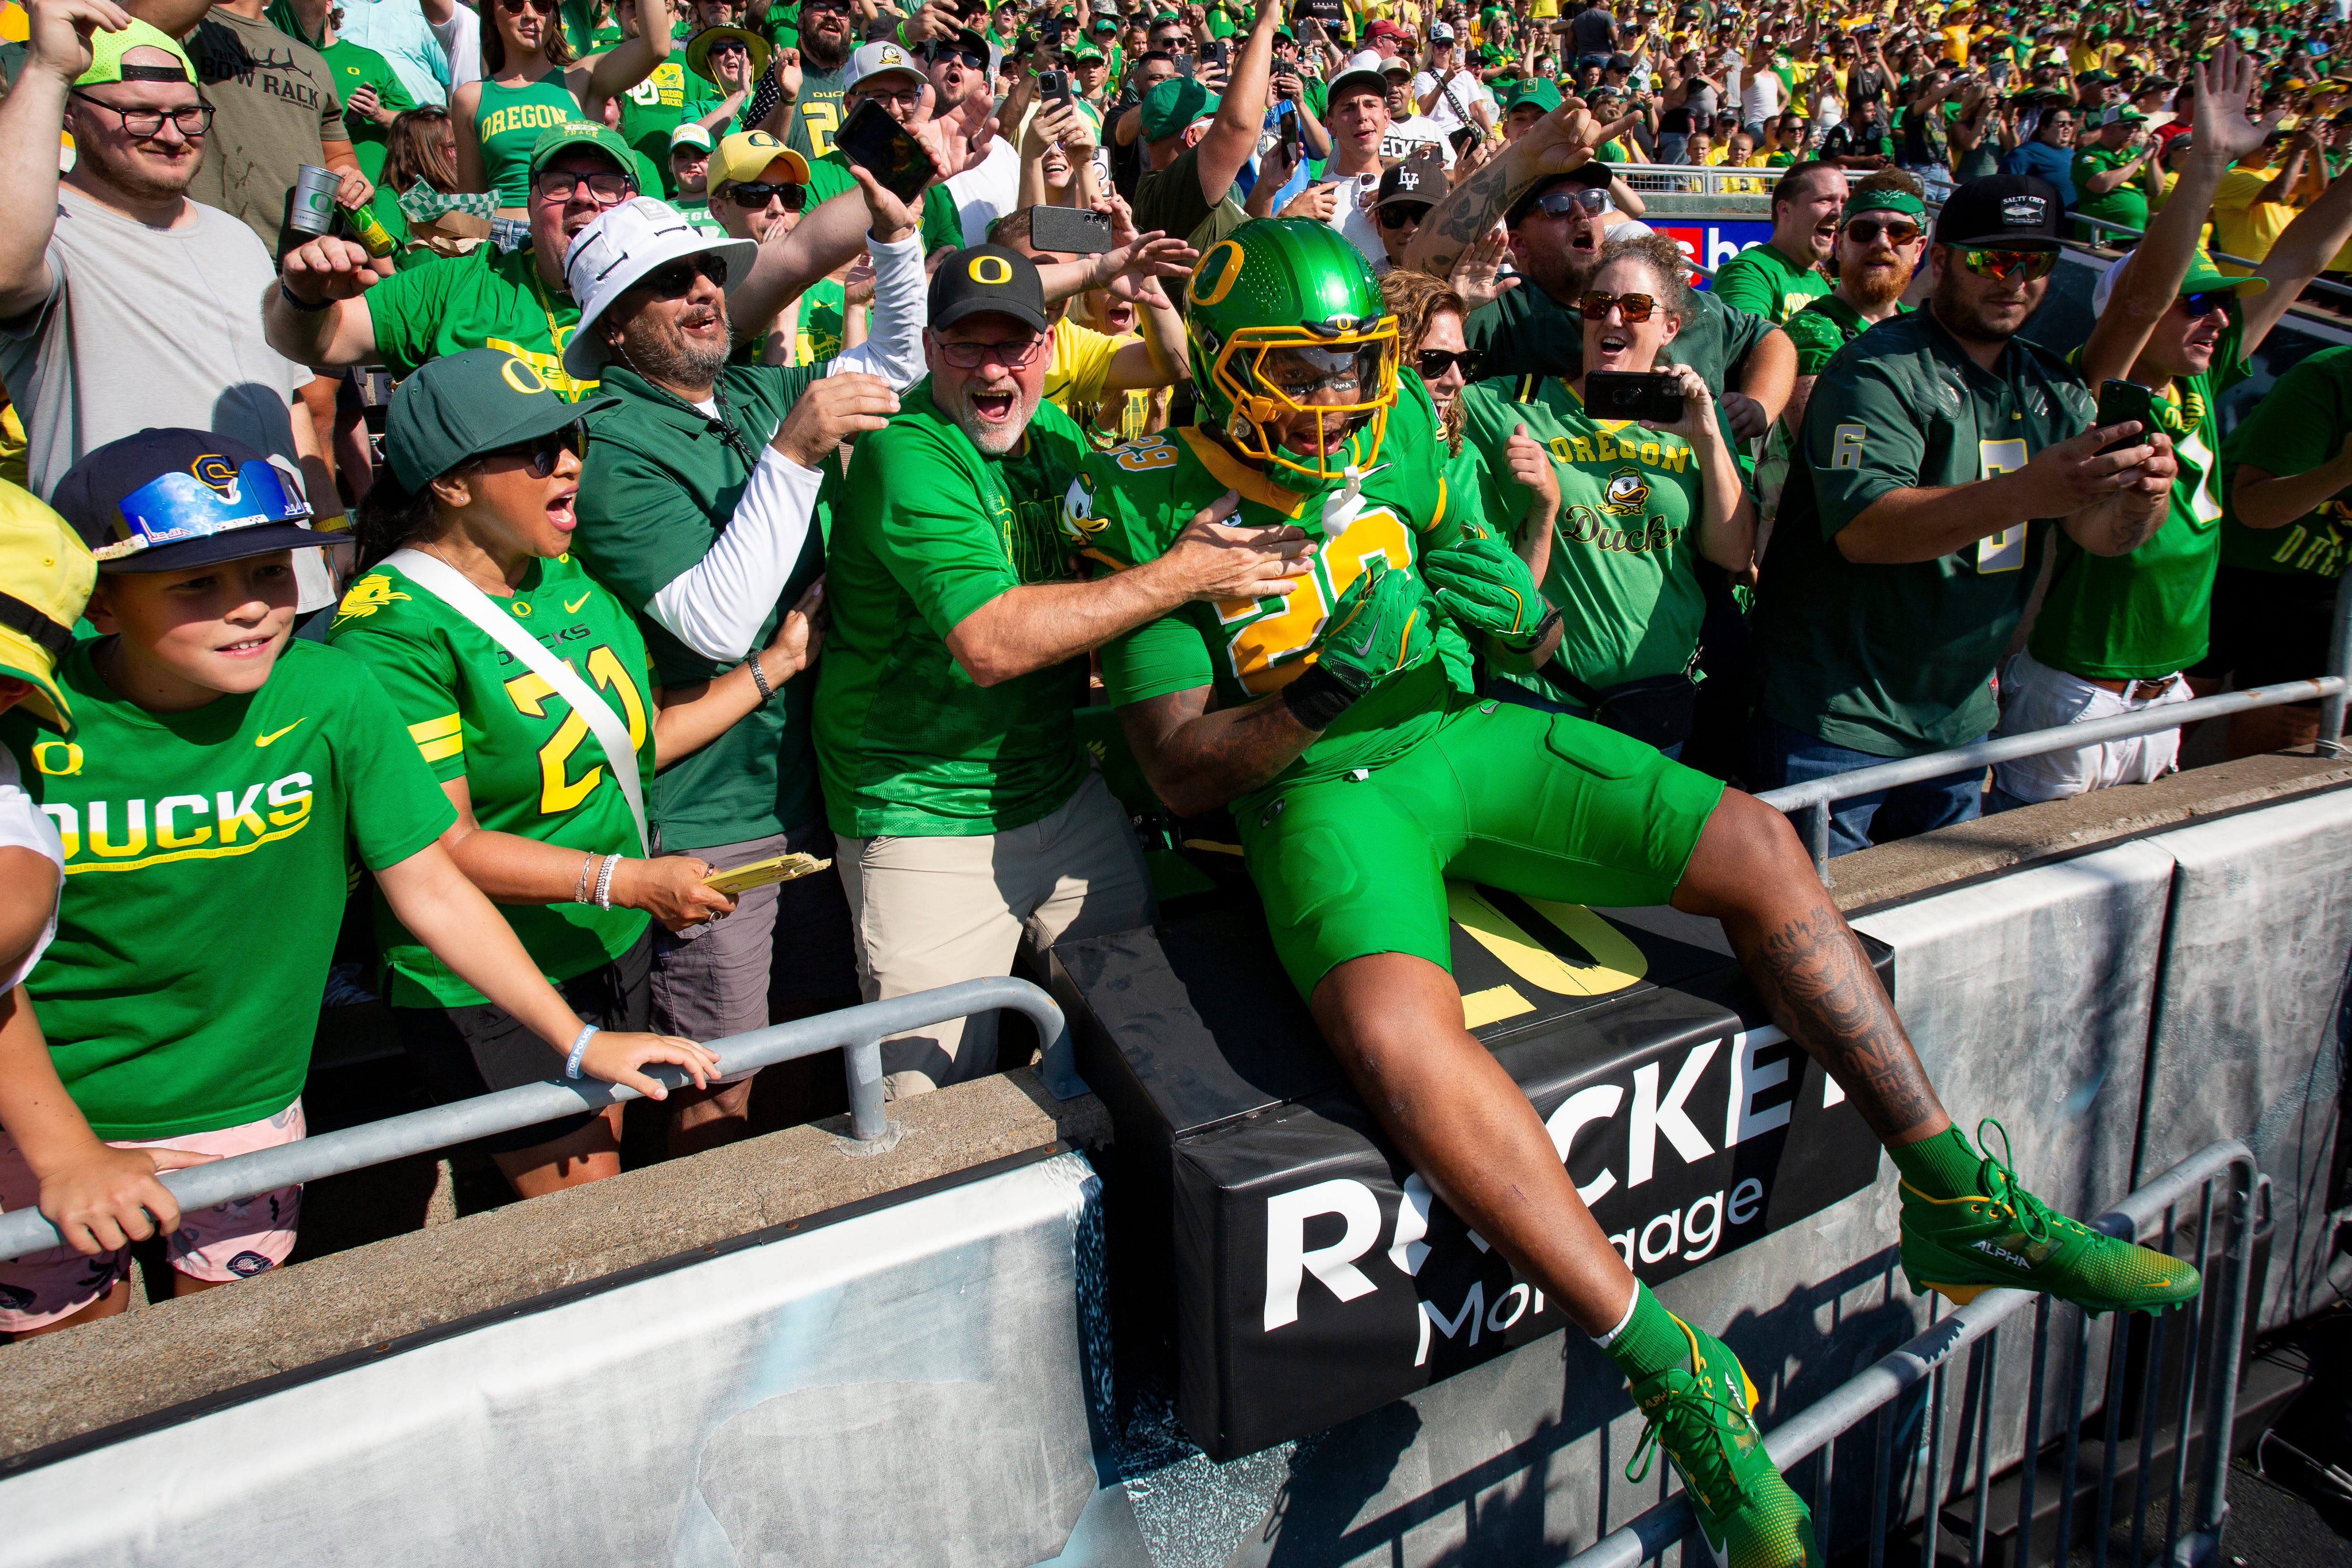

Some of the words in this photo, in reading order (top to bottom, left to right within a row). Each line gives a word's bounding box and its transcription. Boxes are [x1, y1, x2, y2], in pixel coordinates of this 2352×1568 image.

[211, 49, 236, 62] THE
[200, 56, 256, 88] BOW
[263, 73, 319, 110] RACK
[347, 67, 360, 75] O
[659, 89, 684, 100] OREGON
[660, 97, 683, 107] DUCKS
[1446, 90, 1468, 121] GAMEDAY
[482, 104, 568, 144] OREGON
[564, 130, 599, 139] TRACK
[673, 126, 707, 142] OREGON
[801, 101, 849, 158] 2
[748, 132, 780, 147] O
[1398, 166, 1419, 190] LV
[310, 193, 332, 213] O
[2003, 196, 2027, 204] SALTY
[2028, 196, 2047, 205] CREW
[968, 255, 1013, 285] O
[1336, 318, 1352, 330] O
[501, 357, 547, 395] O
[1103, 435, 1179, 472] 29
[1548, 429, 1691, 474] OREGON
[1832, 424, 1867, 469] 6
[1561, 504, 1682, 554] Ducks
[2270, 524, 2352, 578] ORE
[512, 602, 532, 616] O
[498, 623, 592, 666] DCKS
[504, 643, 647, 816] 21
[32, 741, 84, 775] O
[41, 771, 313, 860] DUCKS
[128, 860, 150, 869] EXACT
[151, 850, 208, 862] SPECIFICATIONS
[1970, 1240, 2032, 1270] ALPHA
[1645, 1389, 1668, 1409] ALPH
